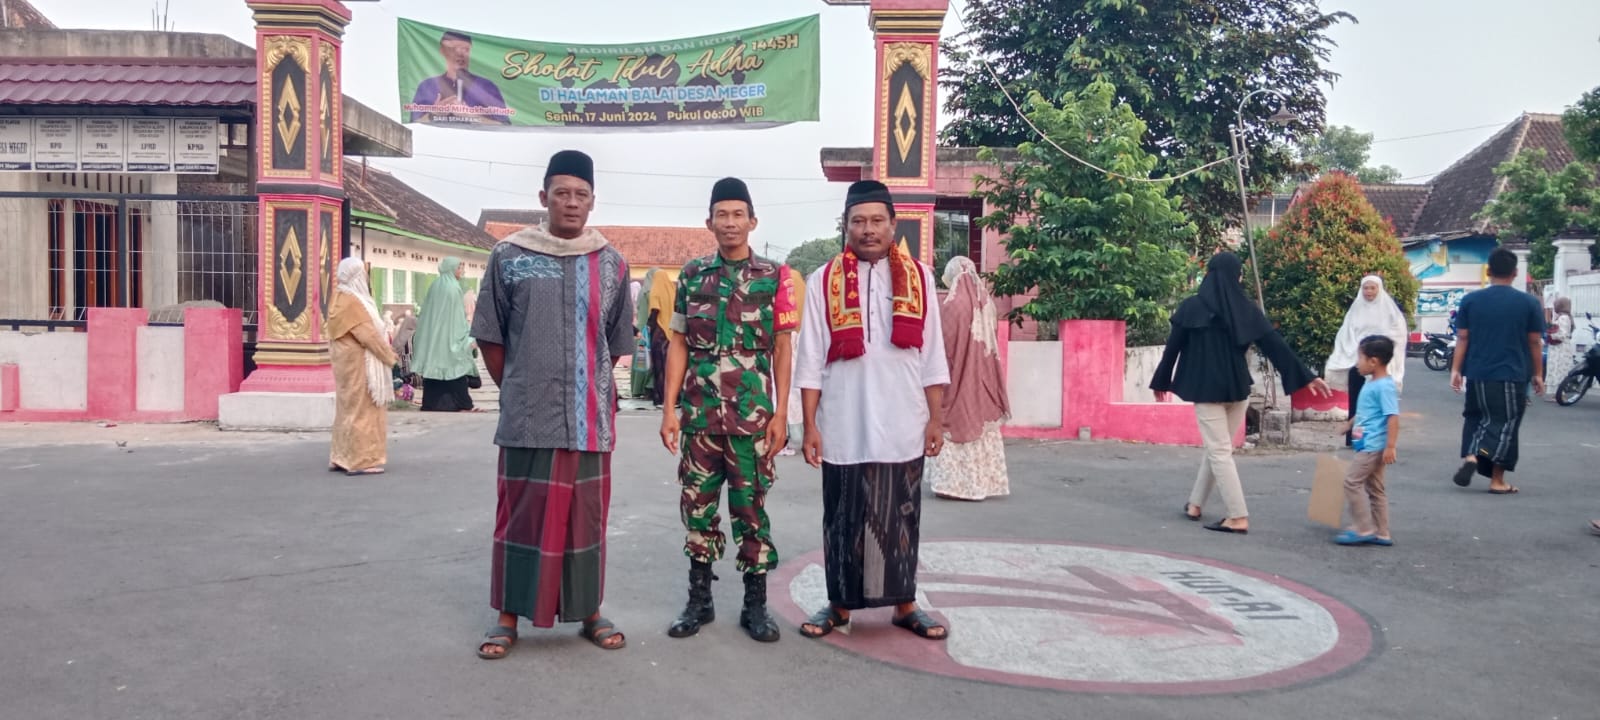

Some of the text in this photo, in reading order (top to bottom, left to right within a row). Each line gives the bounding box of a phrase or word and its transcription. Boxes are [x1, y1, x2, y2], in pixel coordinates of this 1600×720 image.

[659, 41, 695, 51] DAN
[752, 34, 799, 50] 1445H
[501, 43, 764, 83] Sholat Idul Adha
[540, 84, 766, 102] DI HALAMAN BALAI DESA MEGER
[545, 106, 763, 123] Senin, 17 Juni 2024 Pukul 06:00 WIB
